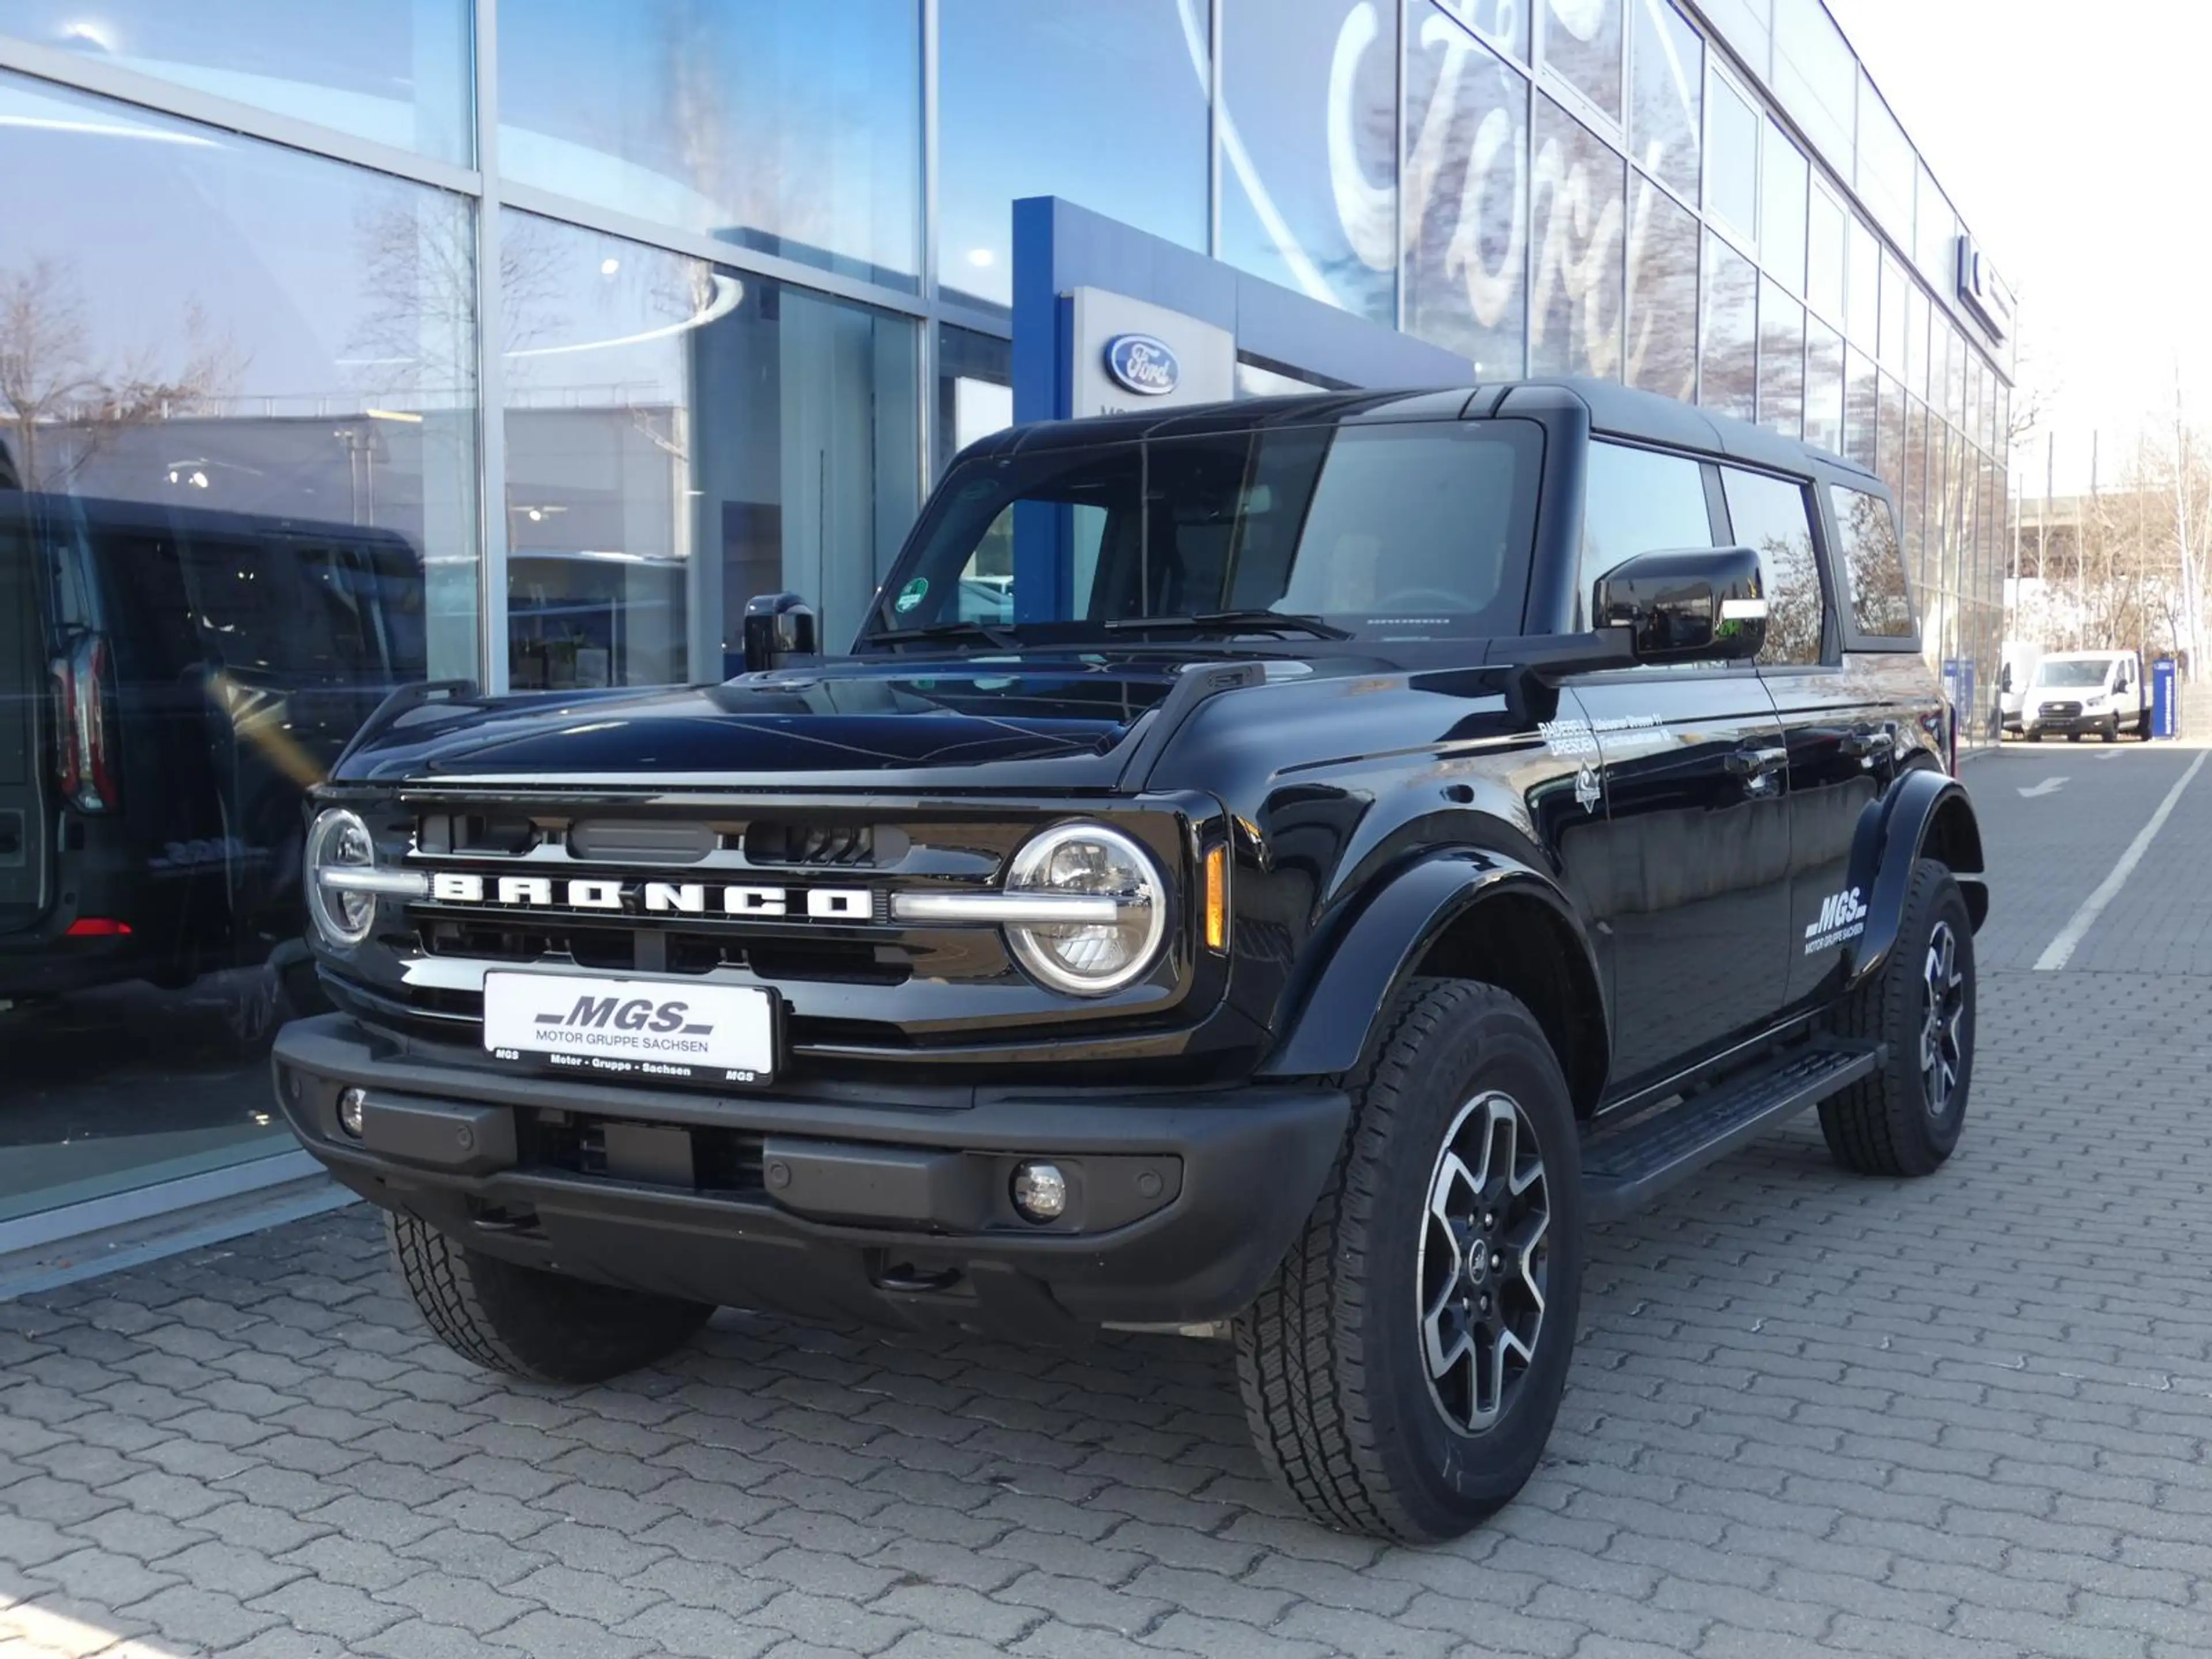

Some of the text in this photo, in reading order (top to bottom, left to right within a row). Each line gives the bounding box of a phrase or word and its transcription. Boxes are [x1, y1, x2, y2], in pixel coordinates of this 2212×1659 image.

[1126, 343, 1171, 385] Ford
[434, 873, 873, 918] BRONCO
[1818, 887, 1861, 933] MGS
[565, 995, 690, 1034] MGS
[495, 1049, 519, 1060] MGS
[536, 1029, 709, 1054] MOTOR GRUPPE SACHSEN
[550, 1054, 582, 1066] Motor
[592, 1058, 631, 1071] Gruppe
[642, 1064, 691, 1076] Sachsen
[725, 1070, 754, 1082] MGS
